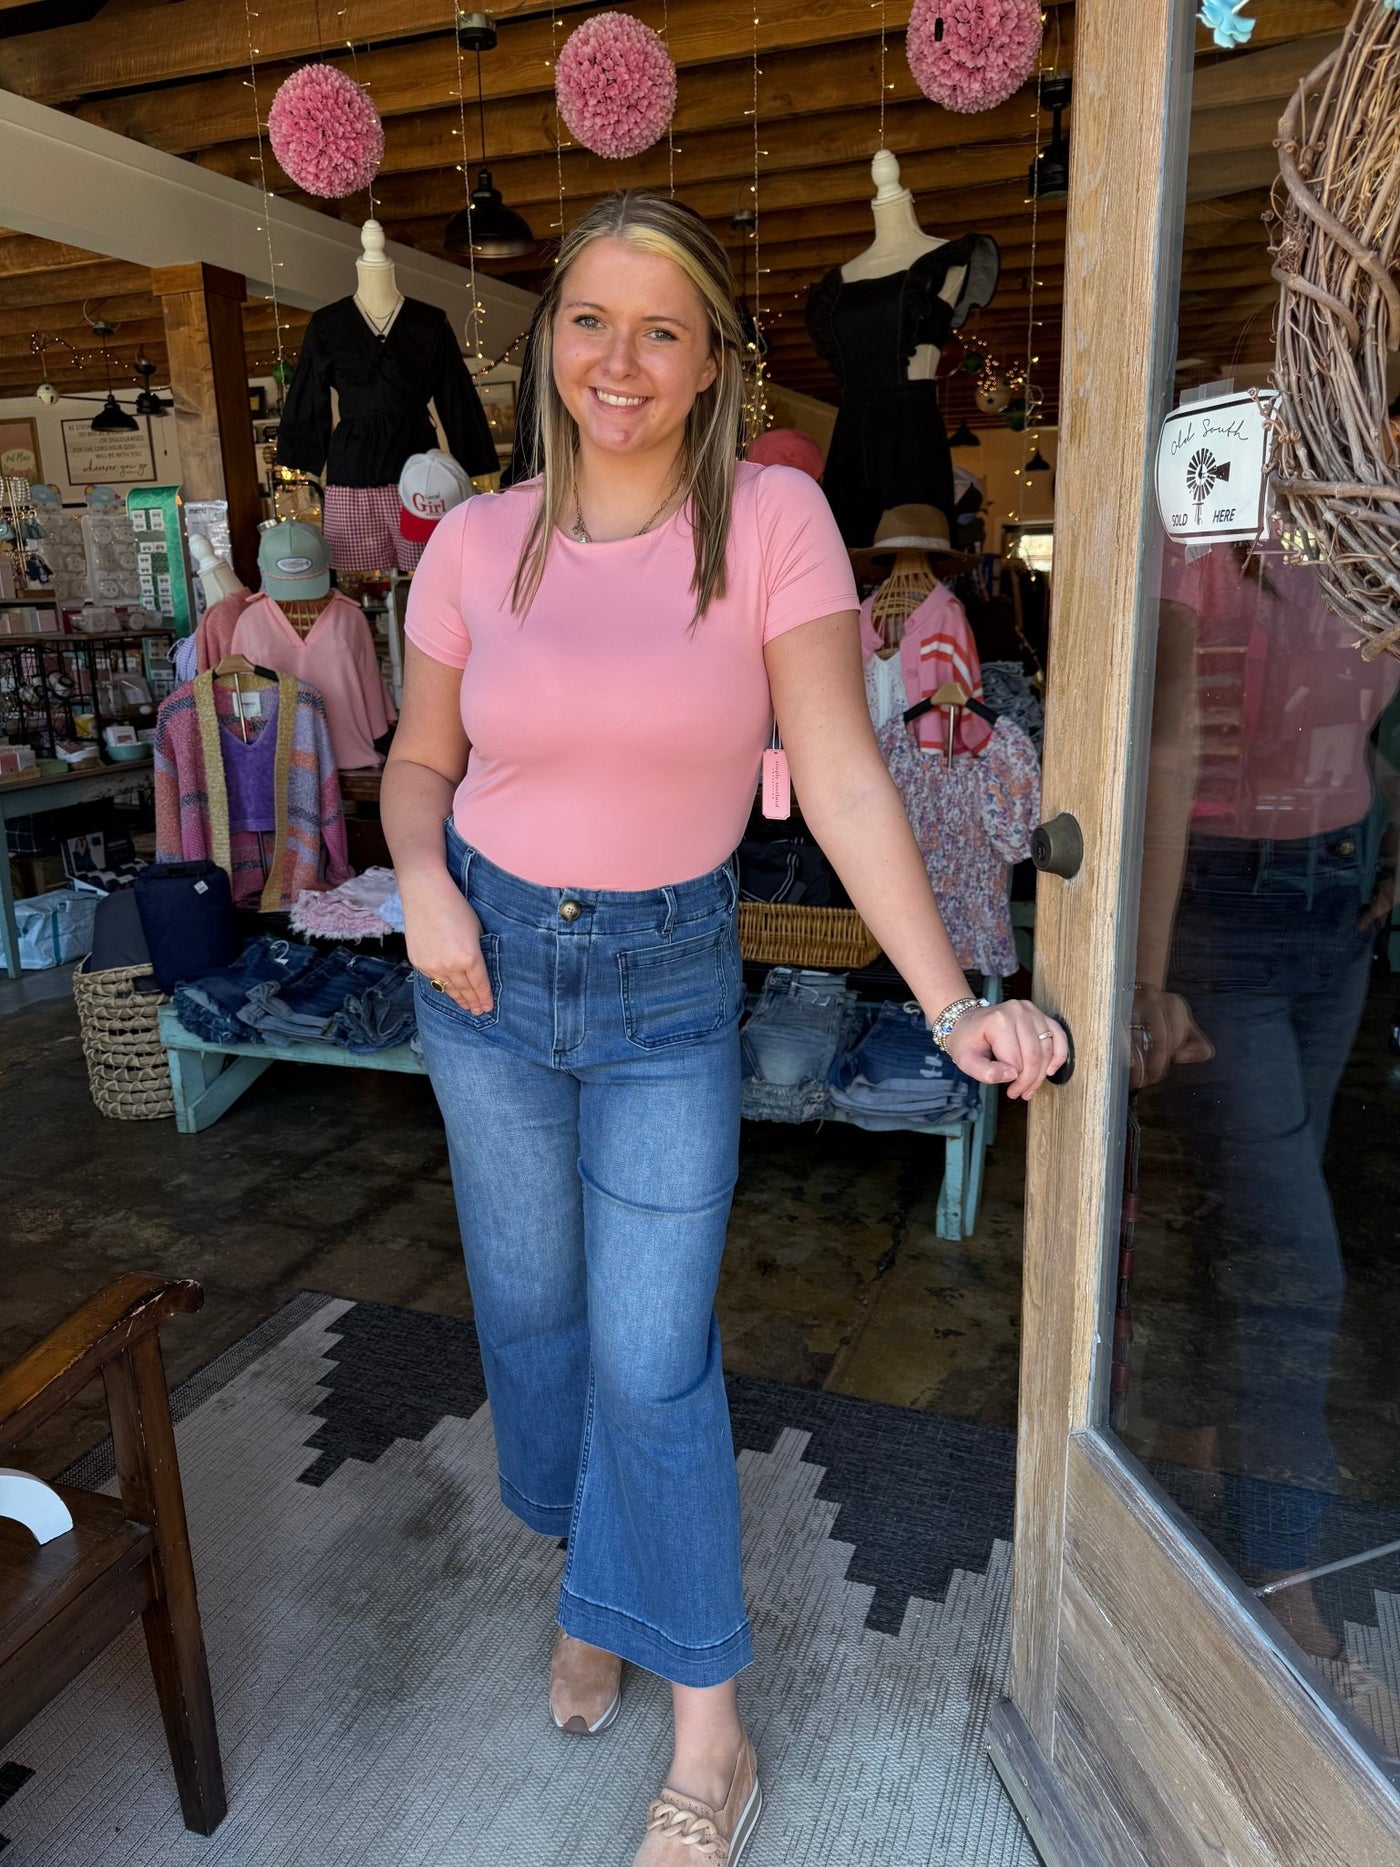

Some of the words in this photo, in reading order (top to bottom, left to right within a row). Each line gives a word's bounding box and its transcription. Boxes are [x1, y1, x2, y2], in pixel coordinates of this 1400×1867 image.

[1170, 421, 1195, 456] Old
[1202, 418, 1249, 441] South
[83, 459, 117, 472] wherever
[120, 464, 136, 478] you
[137, 463, 148, 476] go
[412, 492, 446, 514] Girl
[1171, 513, 1189, 527] SOLD
[1212, 508, 1236, 523] HERE
